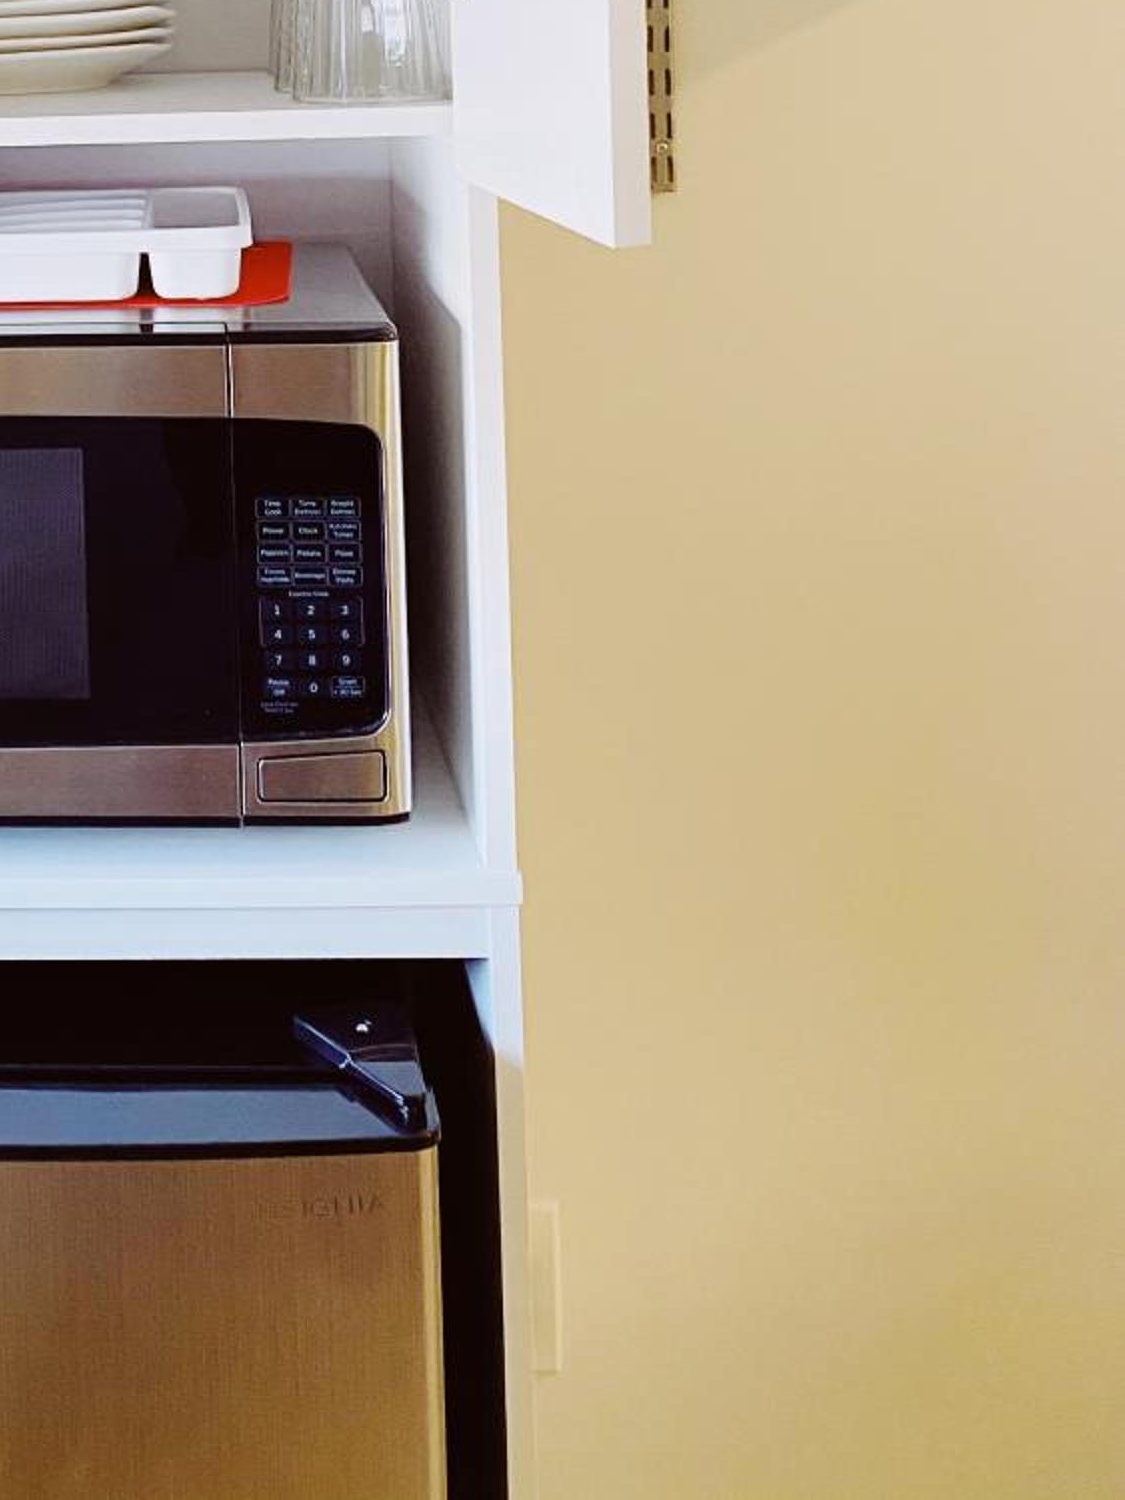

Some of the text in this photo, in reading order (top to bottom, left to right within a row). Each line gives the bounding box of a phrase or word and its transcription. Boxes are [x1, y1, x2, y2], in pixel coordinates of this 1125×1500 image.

[274, 603, 350, 616] 1 2 3
[274, 629, 350, 640] 4 5 6
[275, 654, 351, 666] 7 8 9
[309, 681, 318, 693] 0
